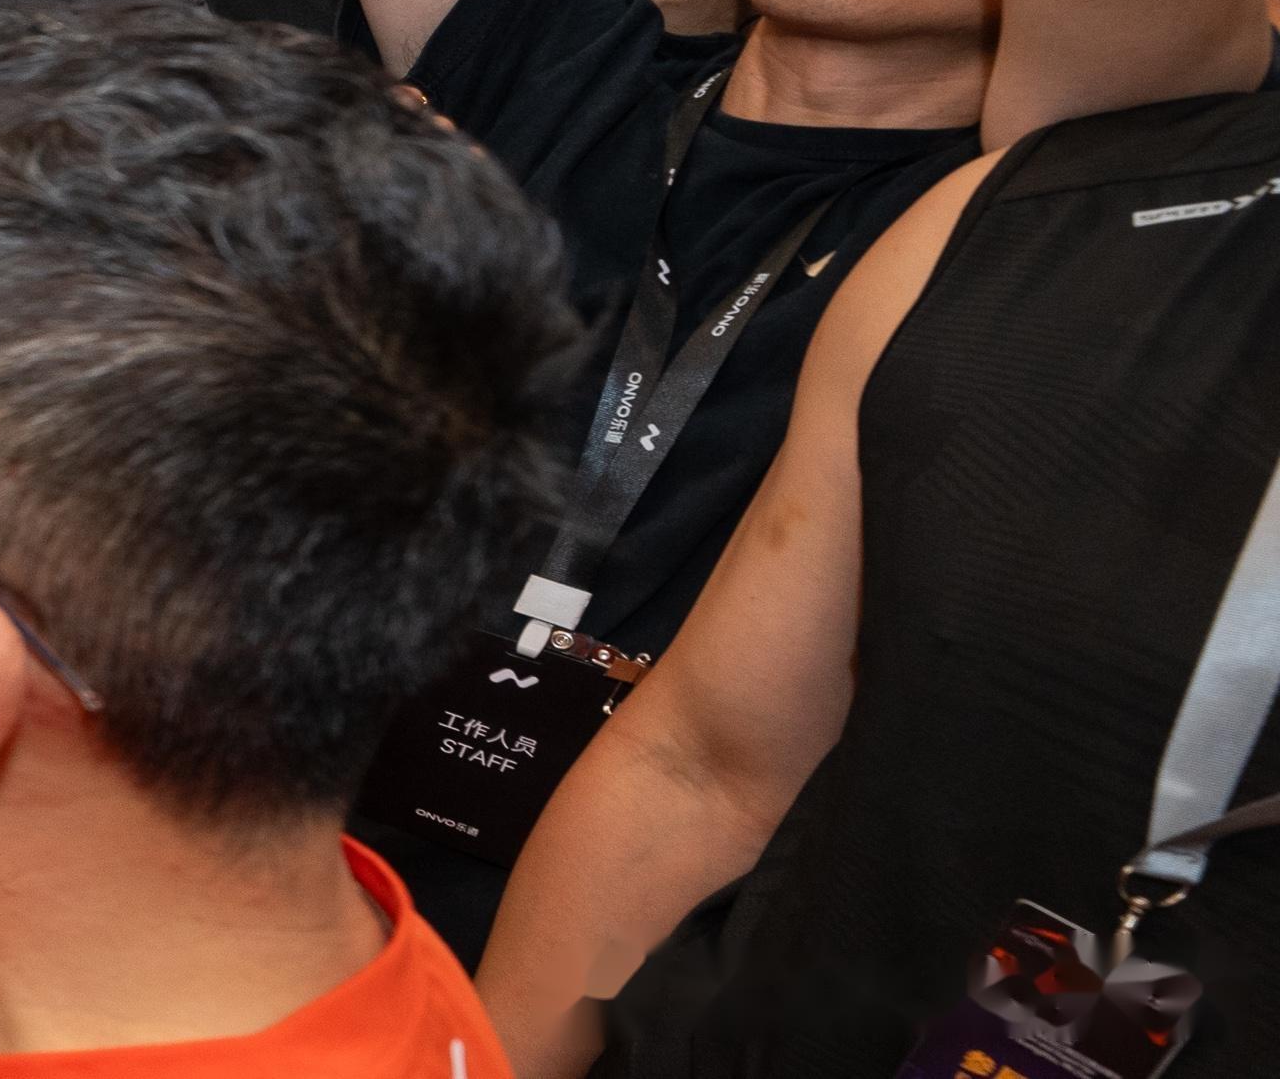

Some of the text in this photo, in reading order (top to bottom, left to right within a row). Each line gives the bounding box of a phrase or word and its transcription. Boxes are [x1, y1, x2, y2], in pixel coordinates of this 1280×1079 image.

[438, 710, 537, 758] 工作人员
[440, 738, 517, 772] STAFF
